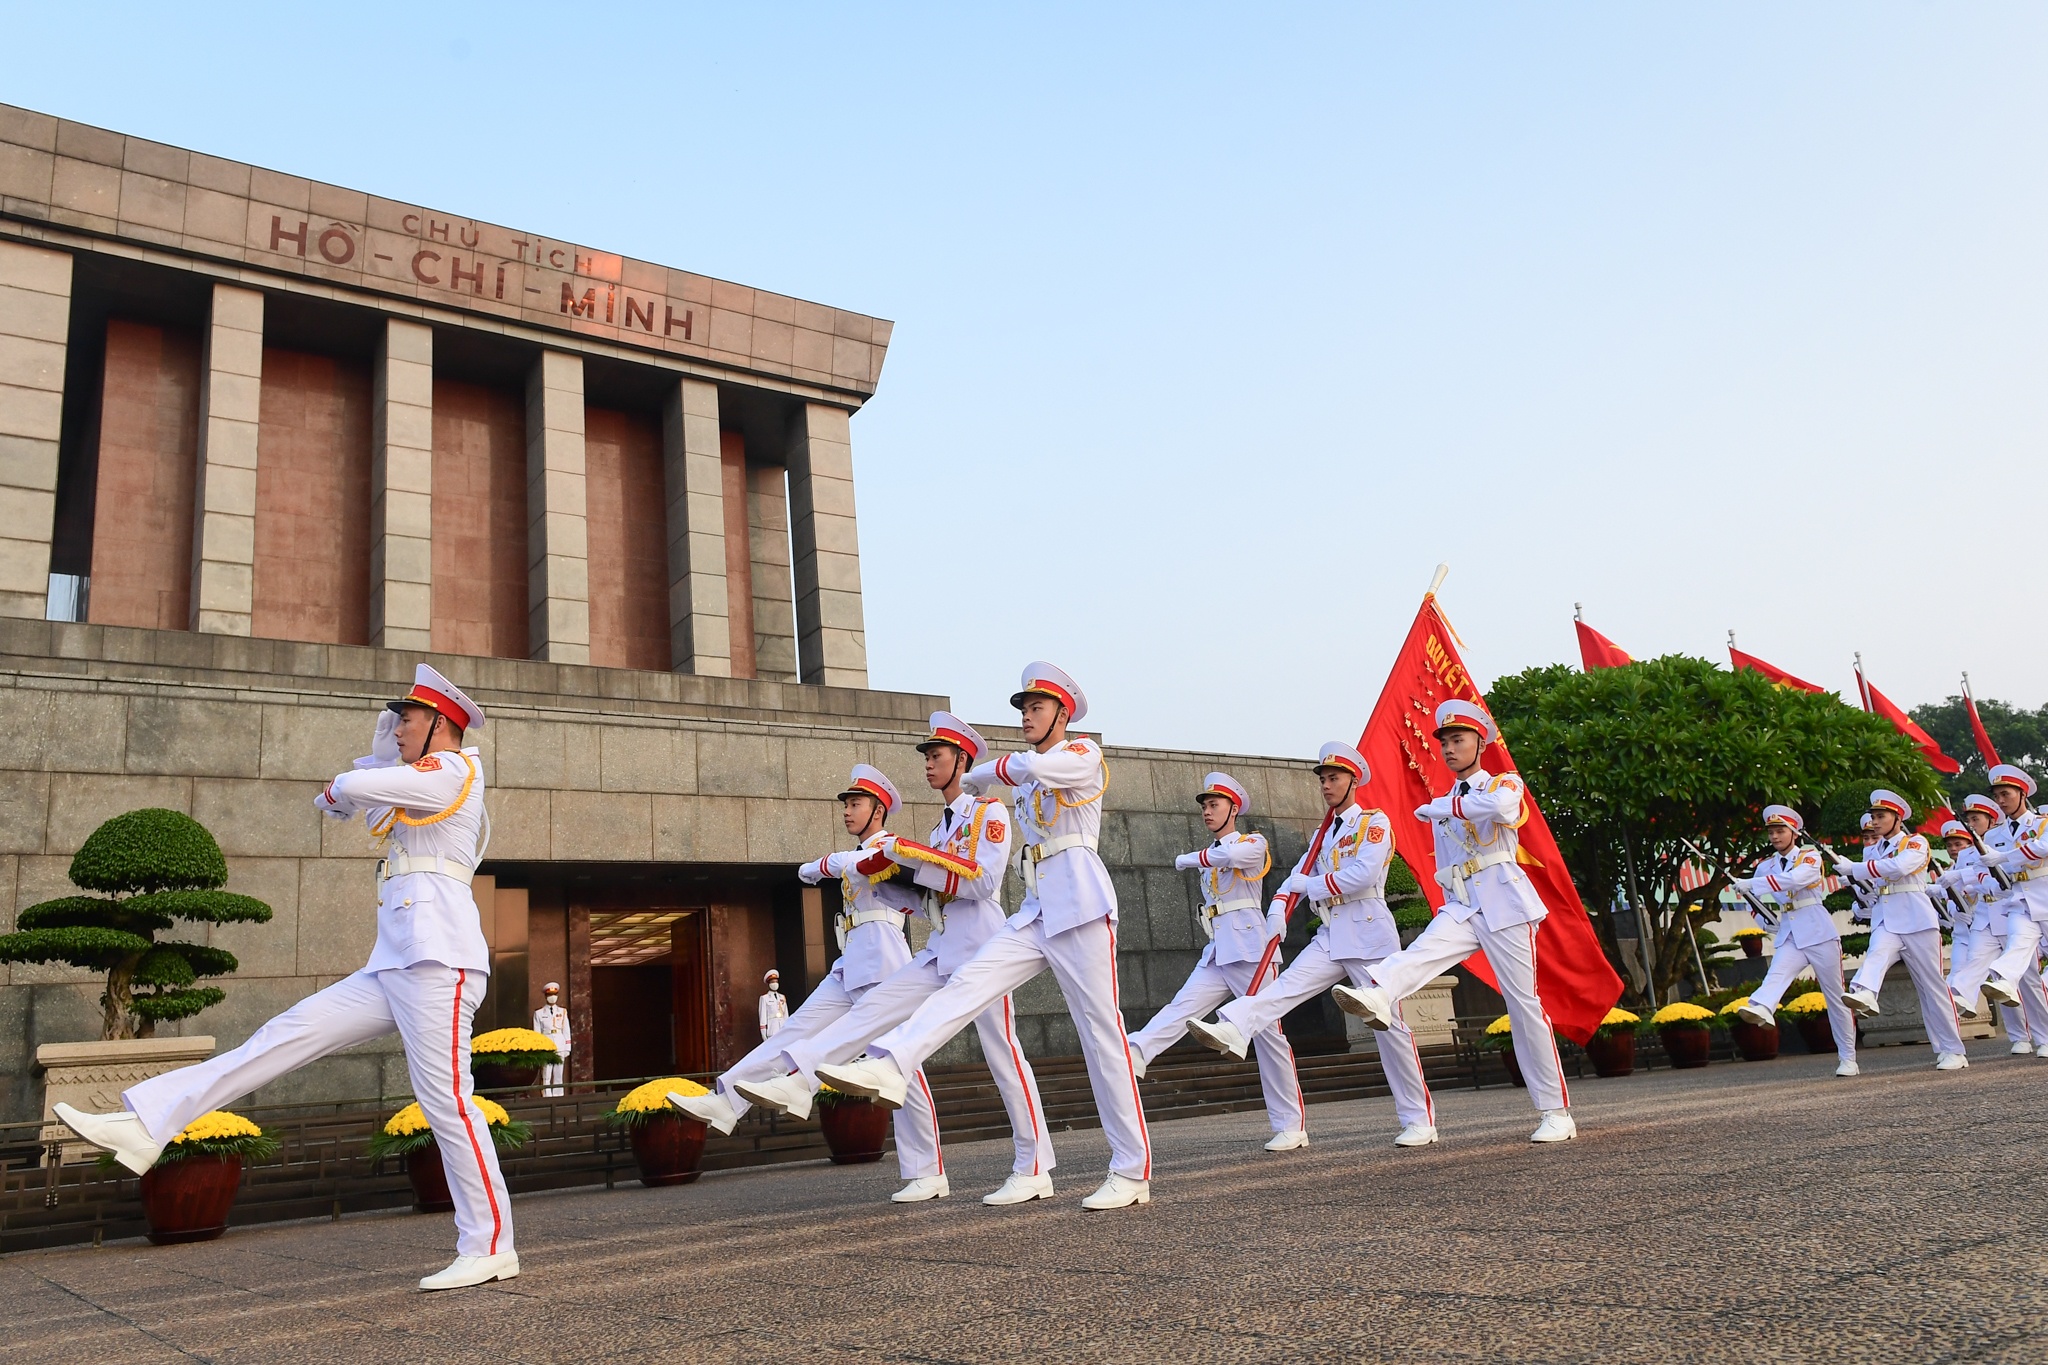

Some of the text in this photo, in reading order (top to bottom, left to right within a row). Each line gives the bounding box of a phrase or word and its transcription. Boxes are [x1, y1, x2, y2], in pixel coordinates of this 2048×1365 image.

[269, 215, 360, 265] HỒ
[411, 250, 511, 300] CHÍ
[401, 213, 480, 248] CHỦ
[1425, 633, 1471, 697] QUYẾT
